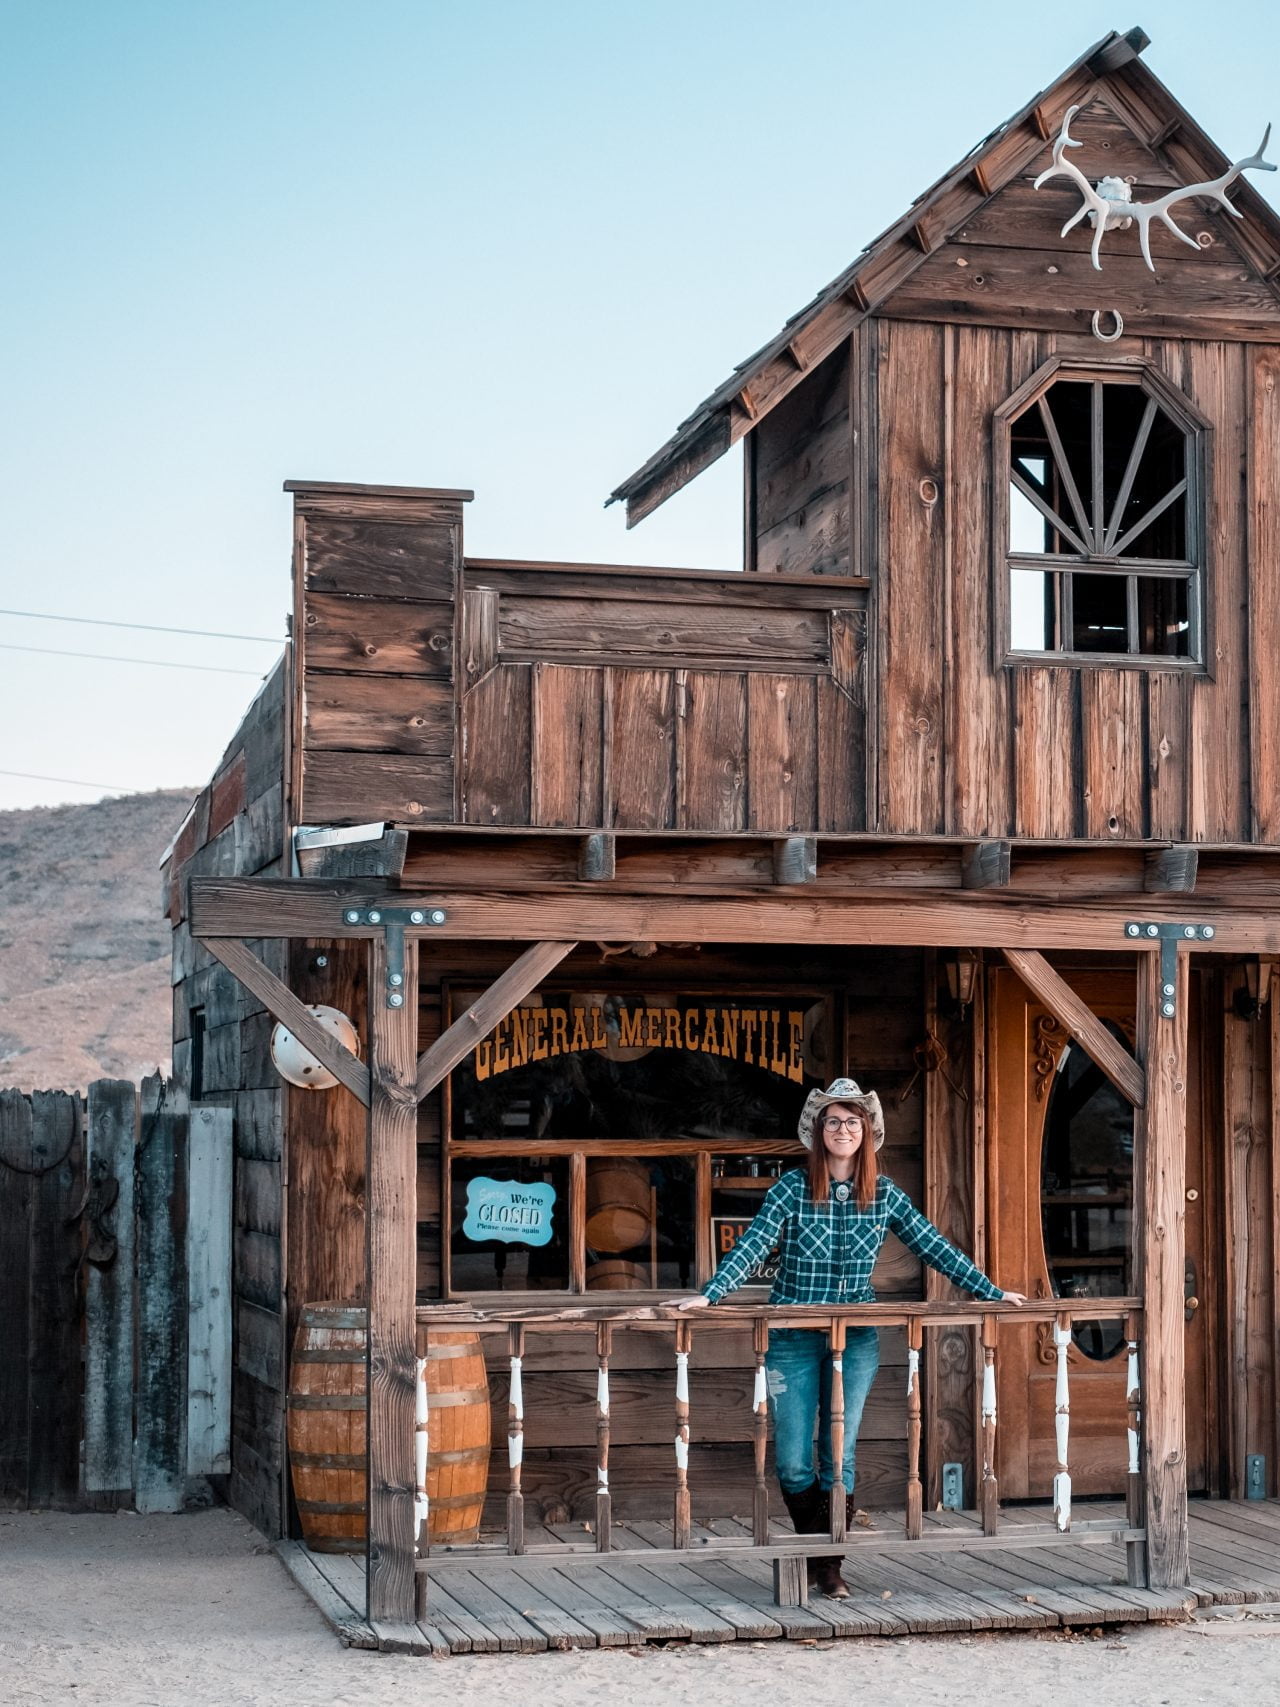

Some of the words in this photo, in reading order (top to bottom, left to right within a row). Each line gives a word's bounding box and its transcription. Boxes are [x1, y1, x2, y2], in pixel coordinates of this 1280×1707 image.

[619, 1008, 803, 1085] MERCANTILE
[511, 1193, 543, 1206] We're
[478, 1203, 541, 1226] CLOSED
